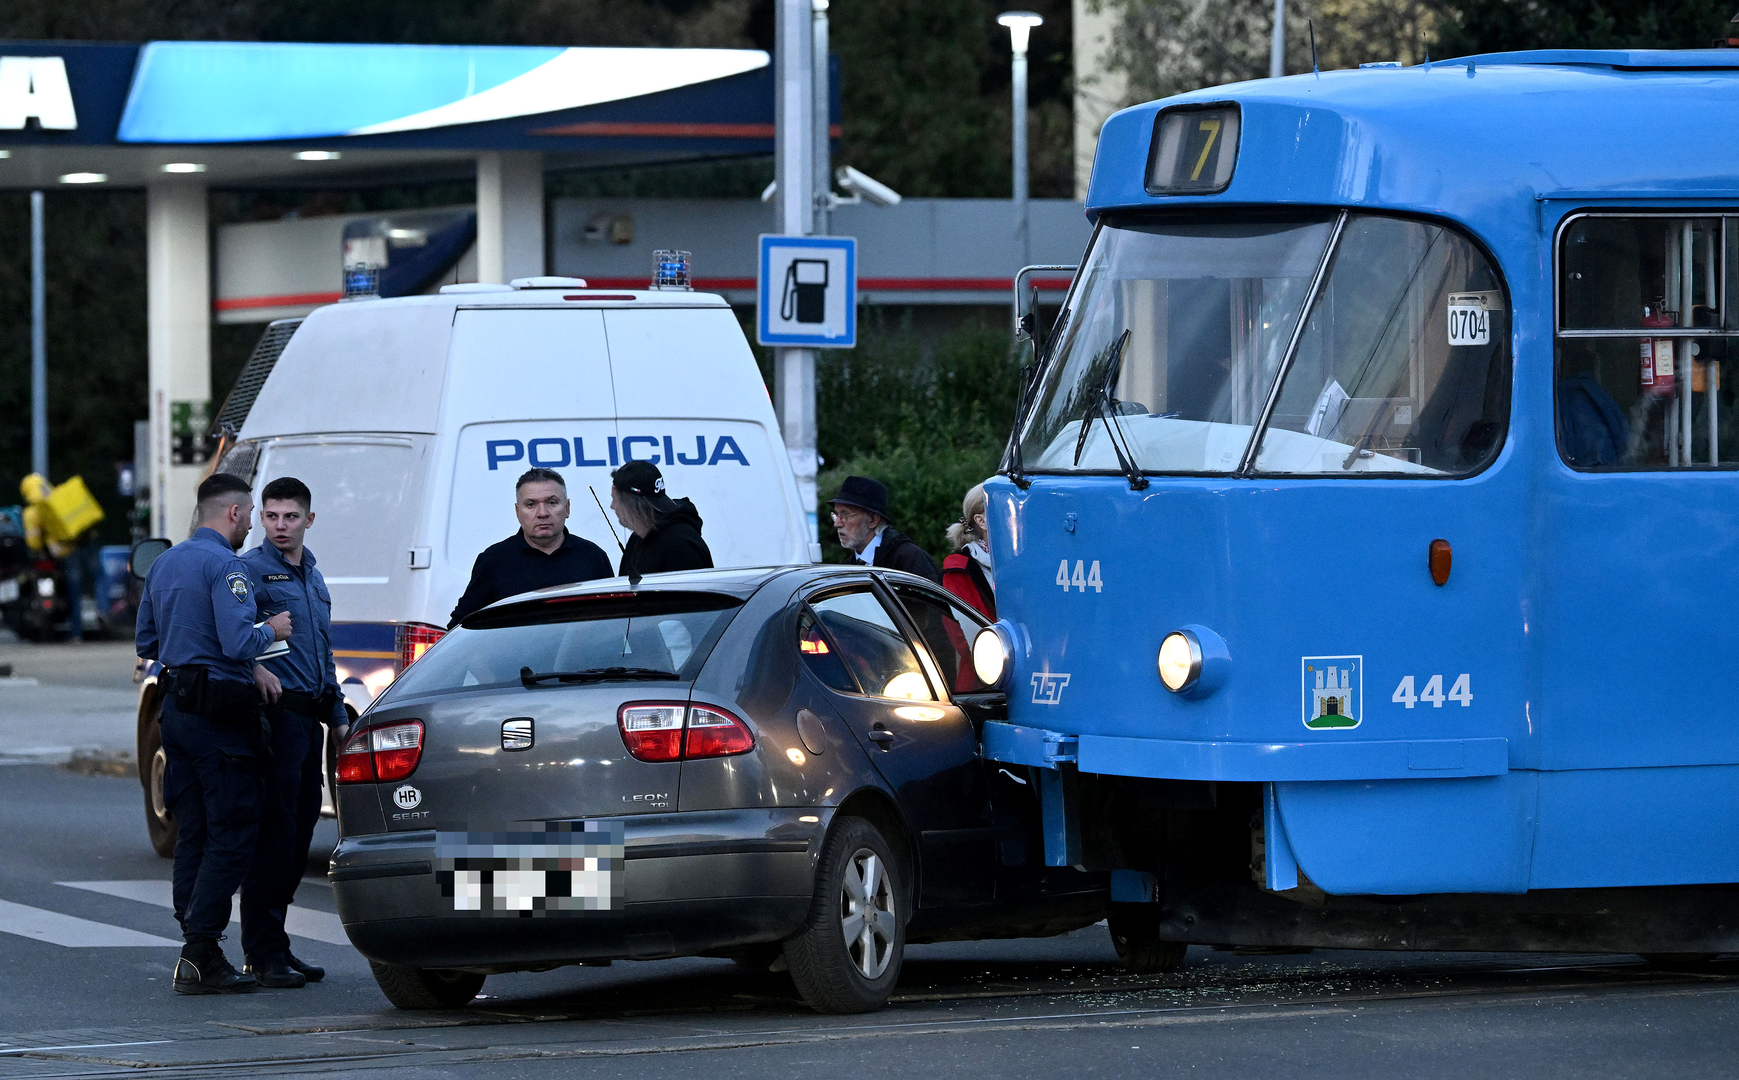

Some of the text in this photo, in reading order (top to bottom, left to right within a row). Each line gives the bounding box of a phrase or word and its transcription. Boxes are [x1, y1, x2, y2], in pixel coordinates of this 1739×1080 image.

[0, 56, 78, 130] A
[1190, 120, 1221, 181] 7
[1450, 310, 1487, 340] 0704
[486, 435, 751, 471] POLICIJA
[1056, 559, 1104, 593] 444
[1030, 672, 1071, 705] ZET
[1391, 673, 1474, 709] 444
[398, 790, 417, 804] HR
[622, 793, 668, 803] LEON
[392, 811, 430, 821] SEAT
